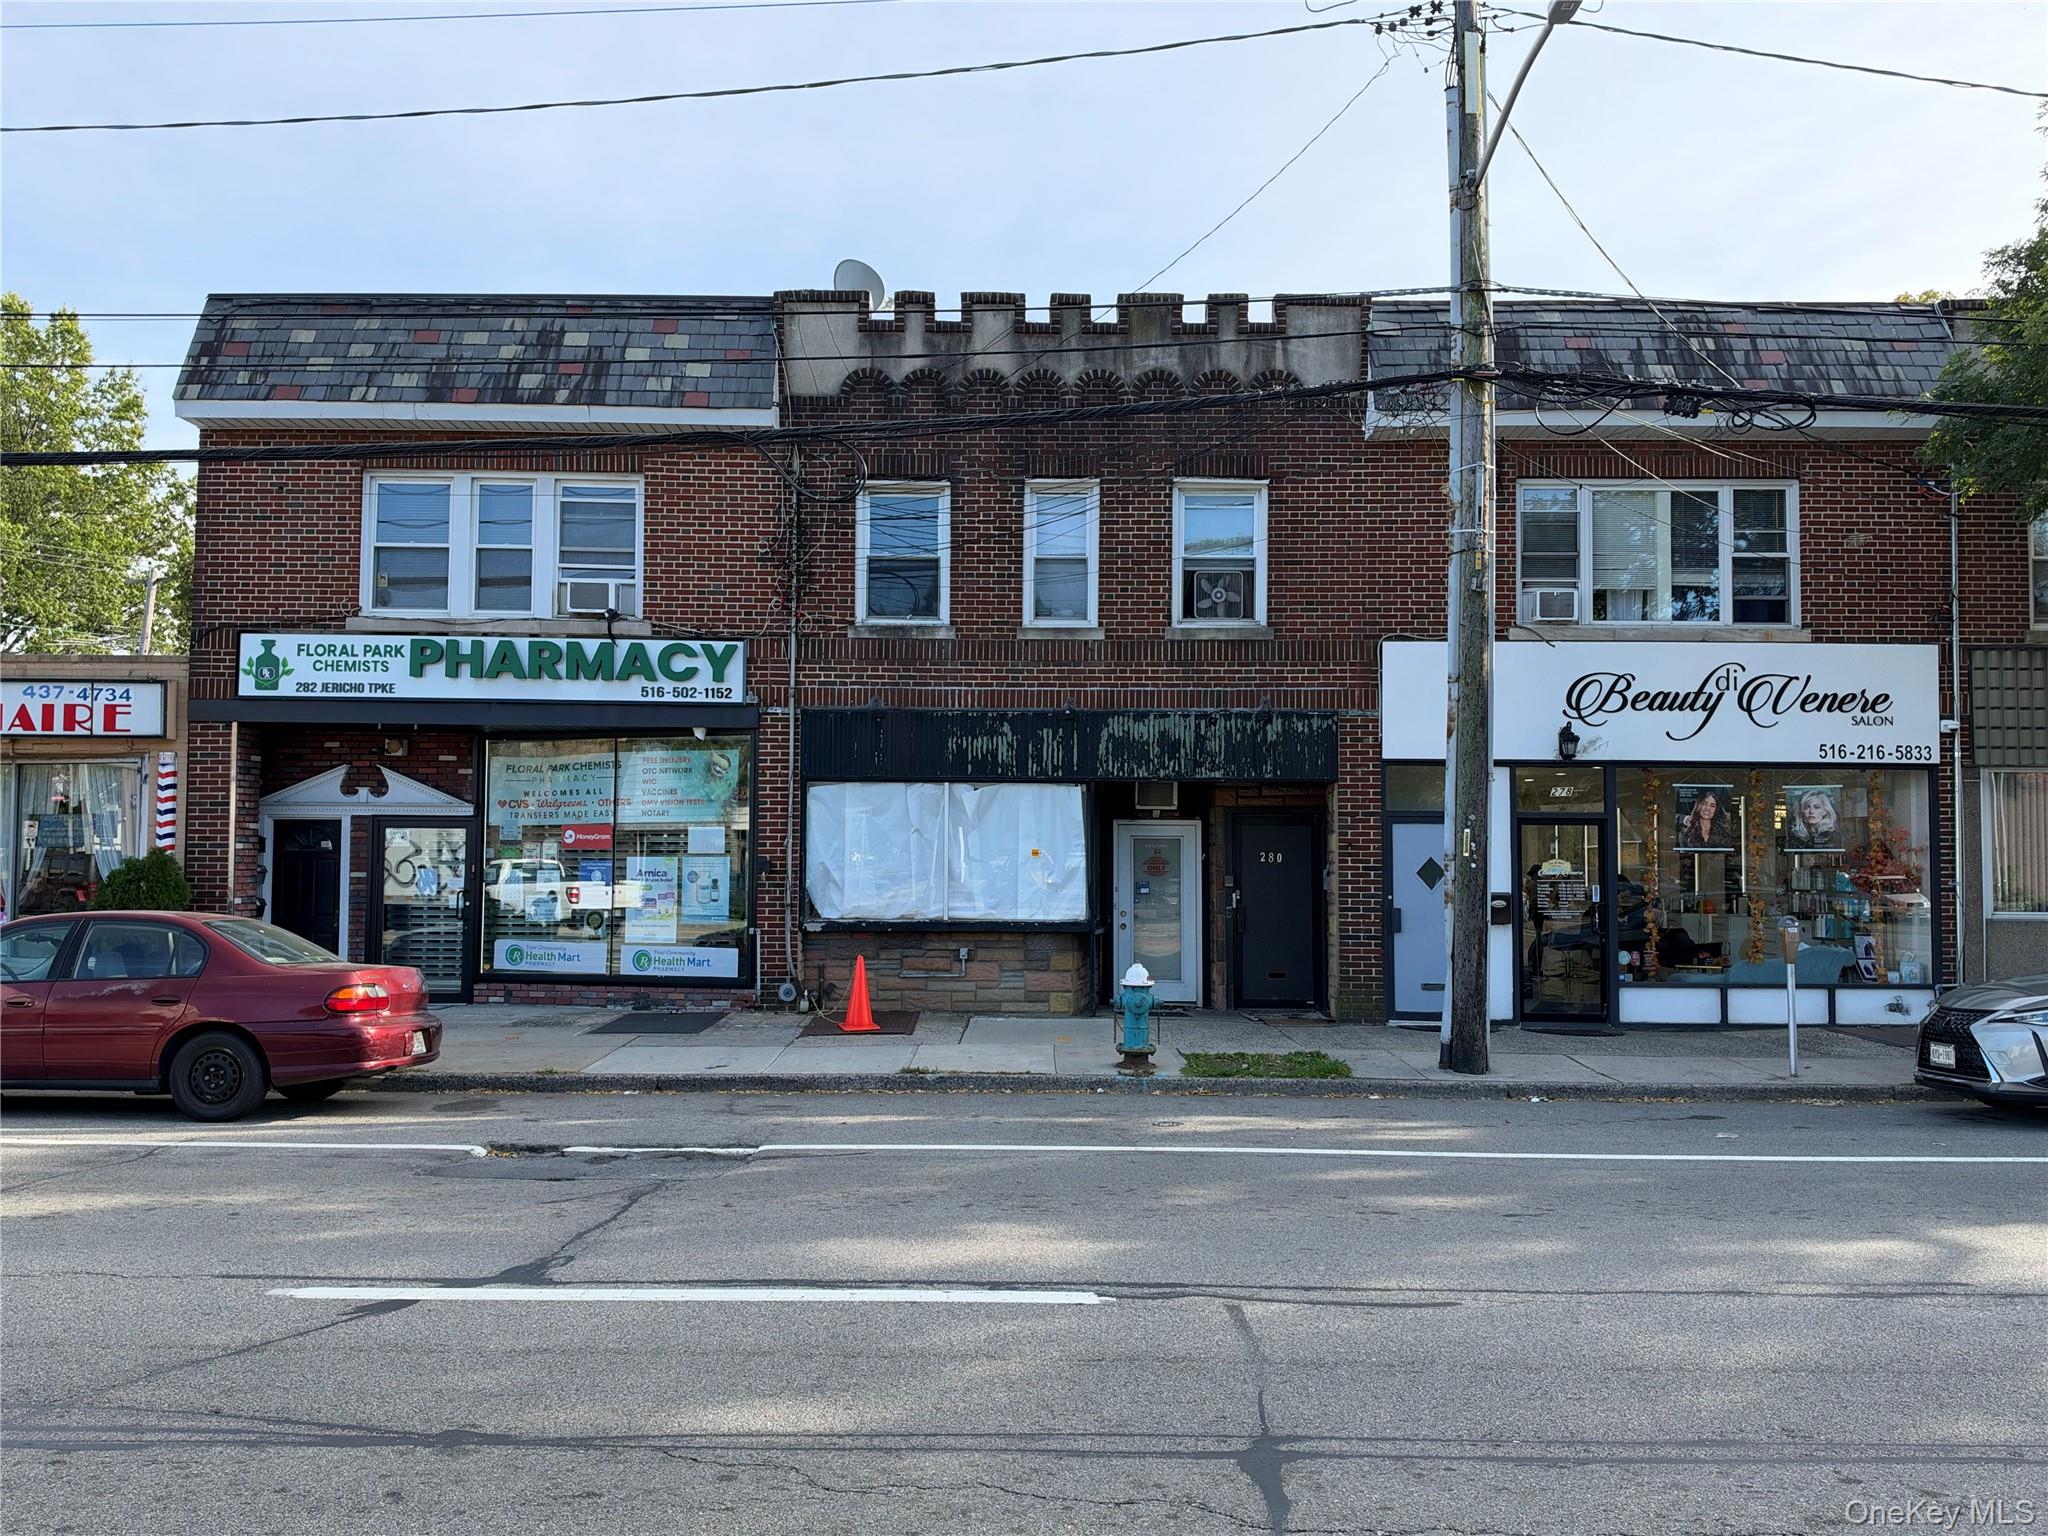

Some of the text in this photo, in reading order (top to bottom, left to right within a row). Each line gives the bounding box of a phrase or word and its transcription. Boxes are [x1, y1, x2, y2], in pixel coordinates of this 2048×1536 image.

[296, 643, 405, 658] FLORAL PARK
[312, 660, 390, 673] CHEMISTS
[409, 639, 738, 683] PHARMACY
[295, 682, 396, 694] 282 JERICHO TPKE
[641, 686, 733, 699] 516-502-1152
[1562, 662, 1894, 741] Beauty di Venere
[0, 703, 132, 732] AIRE
[1851, 715, 1894, 727] SALON
[1819, 744, 1932, 761] 516-216-5833
[505, 760, 622, 774] FLORAL PARK CHEMISTS
[531, 774, 597, 785] PHARMACY
[523, 789, 580, 797] WELCOMES
[641, 788, 678, 796] VACCINES
[1551, 787, 1572, 796] 278
[508, 800, 529, 809] CVS
[537, 799, 588, 811] Walgreens
[509, 811, 559, 820] TRANSFERS
[563, 810, 588, 819] MADE
[576, 833, 611, 841] MoneyGram
[1259, 852, 1282, 863] 280
[636, 868, 667, 878] Arnica
[525, 951, 556, 962] Health
[557, 952, 581, 962] Mart
[653, 956, 686, 967] Health
[687, 957, 711, 967] Mart
